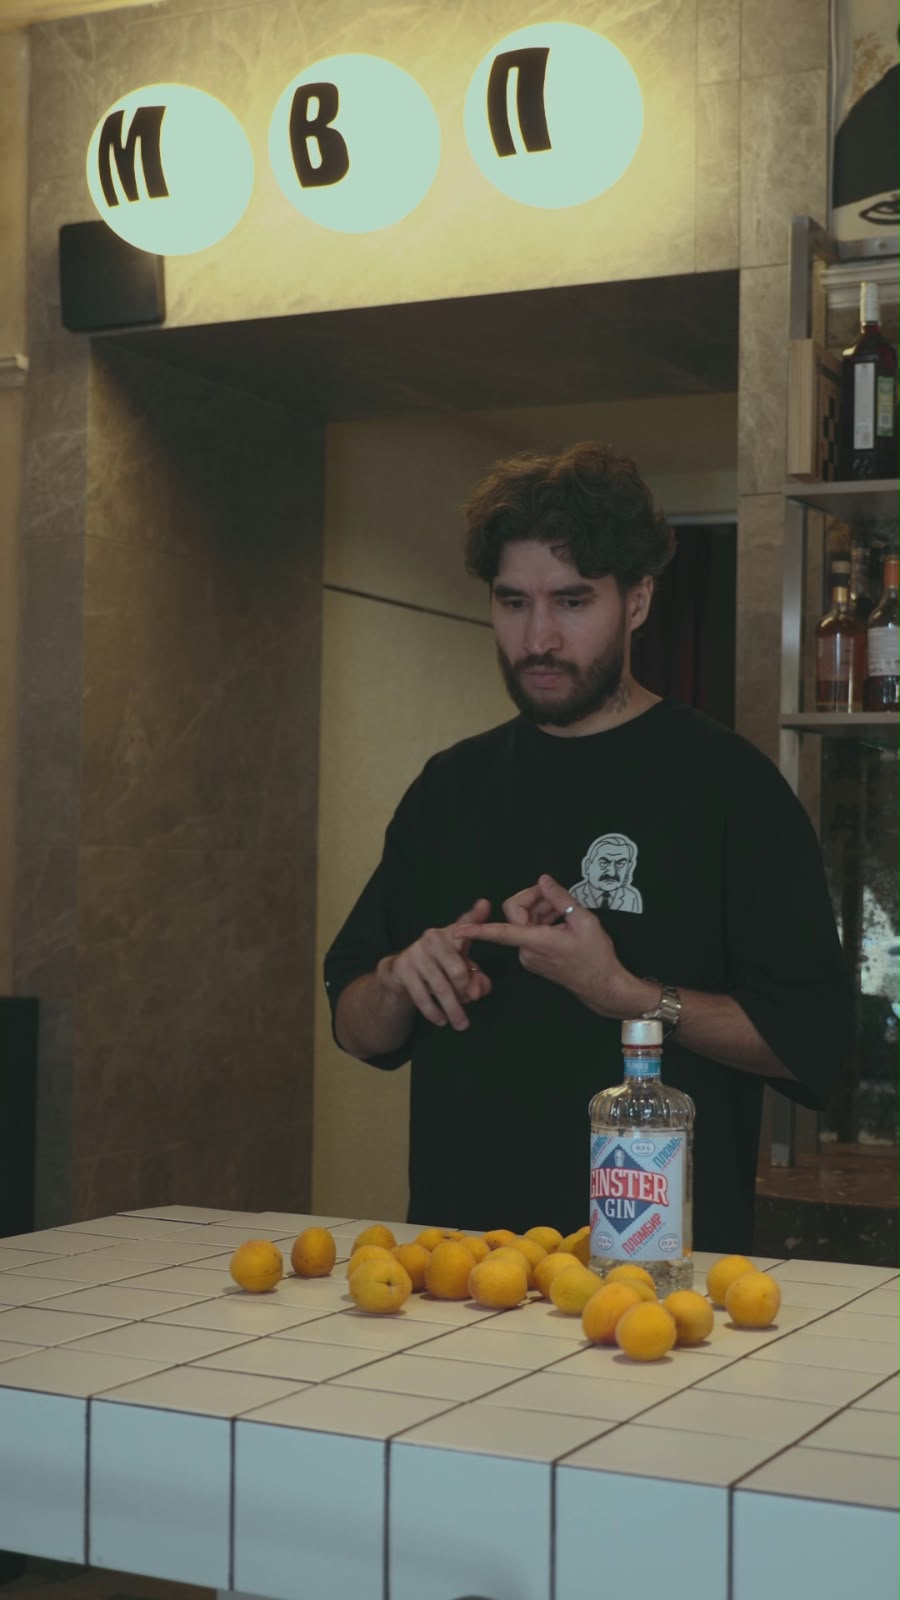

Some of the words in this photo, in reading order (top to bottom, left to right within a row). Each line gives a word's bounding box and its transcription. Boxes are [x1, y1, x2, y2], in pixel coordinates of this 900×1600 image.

[97, 105, 169, 208] М
[289, 82, 350, 188] В
[486, 46, 552, 158] П
[590, 1167, 668, 1206] GINSTER
[604, 1198, 636, 1219] GIN
[621, 1212, 663, 1255] ПЛОМБИР
